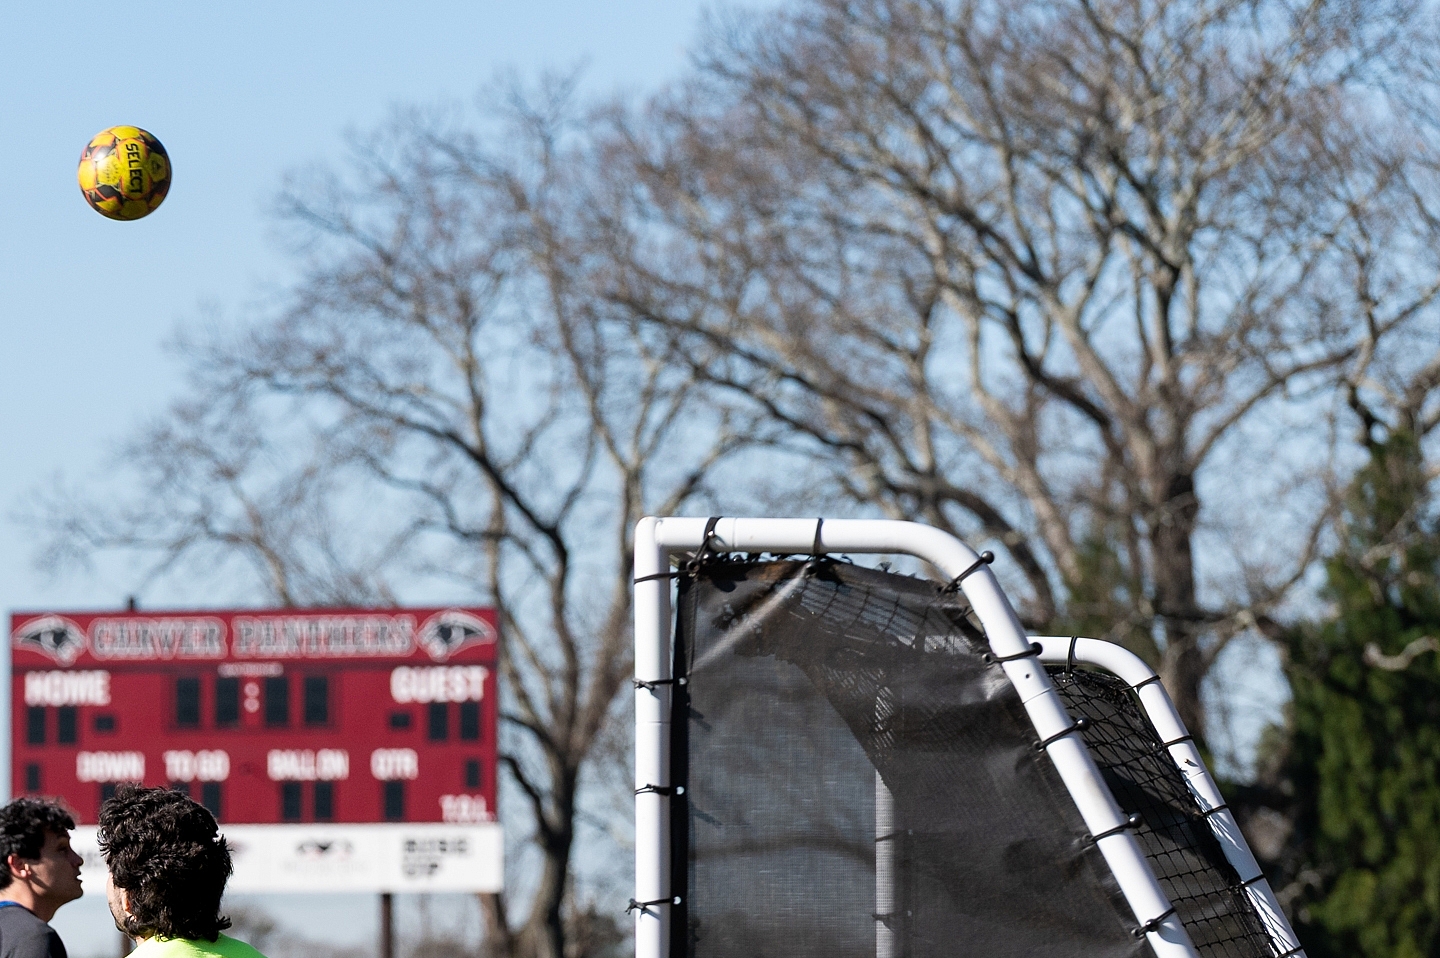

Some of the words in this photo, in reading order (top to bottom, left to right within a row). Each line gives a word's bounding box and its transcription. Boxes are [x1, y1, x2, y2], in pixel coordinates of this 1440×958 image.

[126, 143, 143, 194] SELECT
[92, 618, 226, 659] CARVER
[234, 616, 416, 657] PANTHERS
[25, 671, 110, 706] HOME
[391, 666, 488, 703] GUEST
[77, 752, 146, 782] DOWN
[164, 750, 195, 782] TO
[195, 750, 230, 782] GO
[267, 749, 315, 781] BALL
[316, 748, 349, 781] ON
[371, 748, 419, 780] QTR
